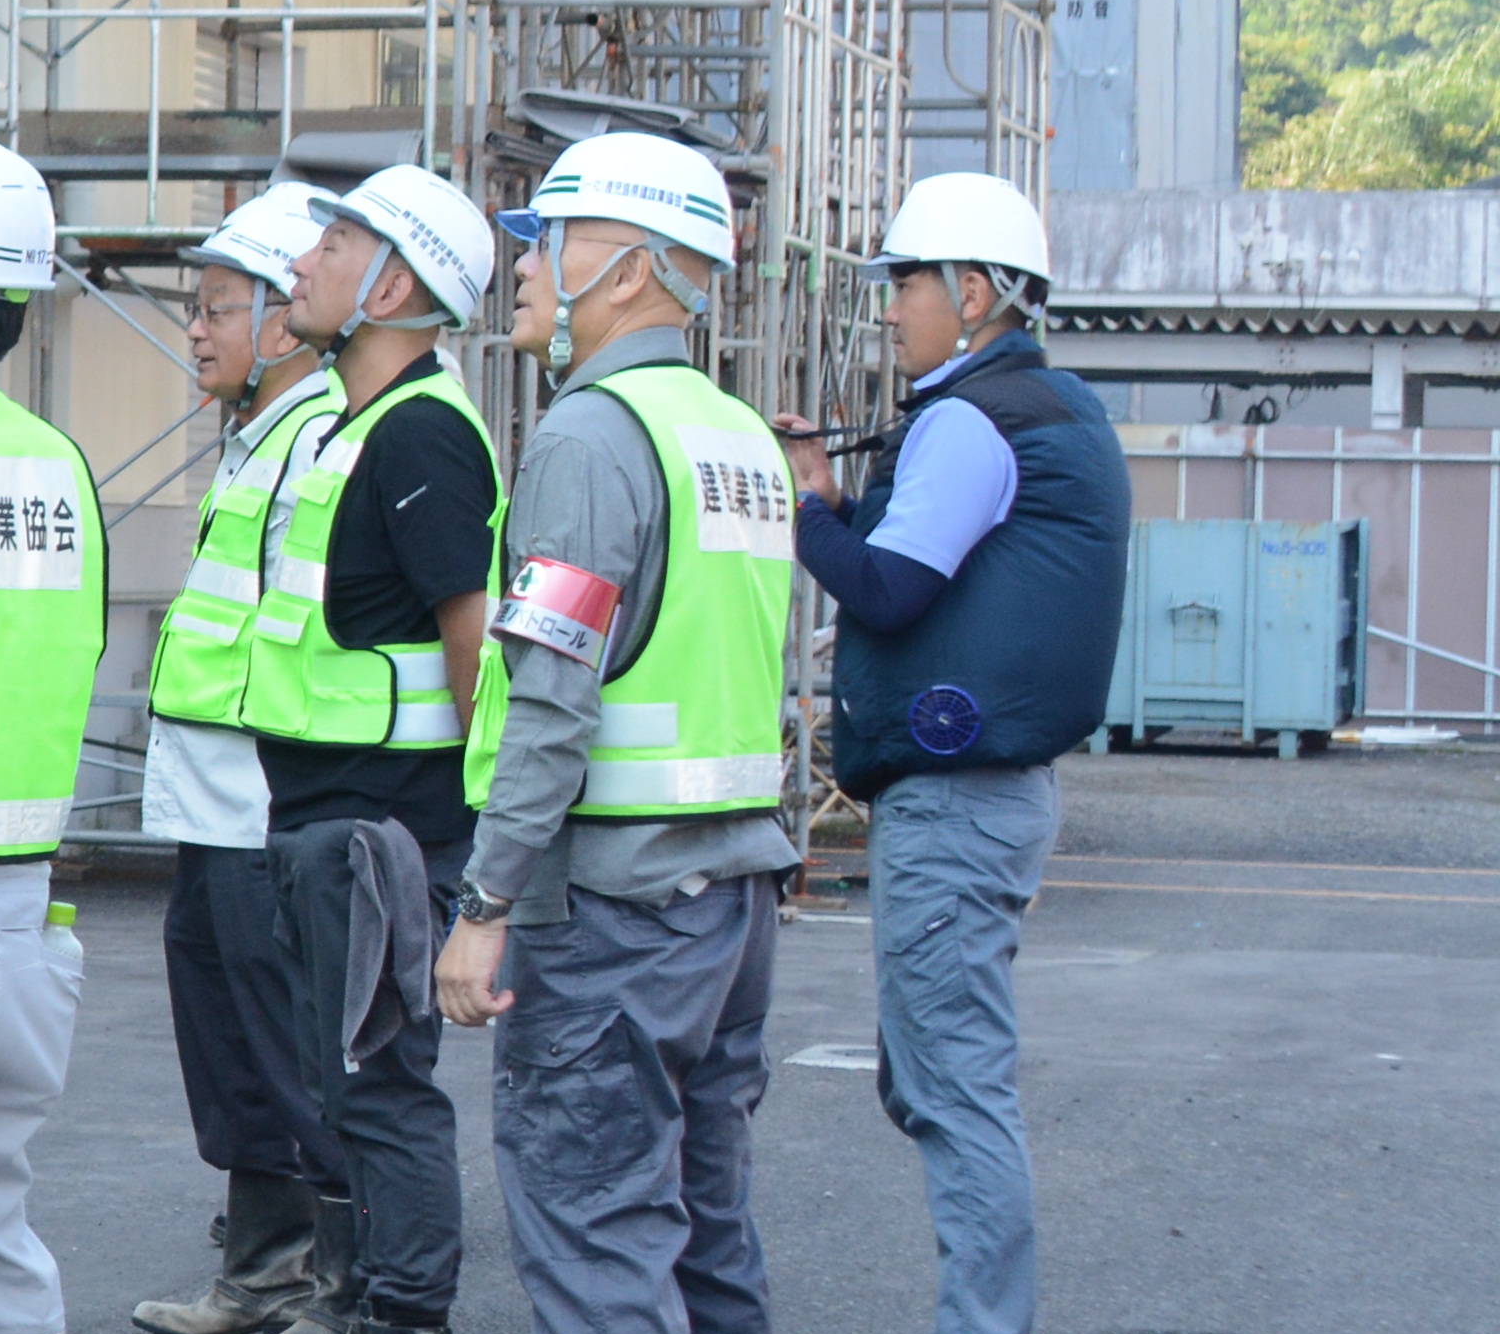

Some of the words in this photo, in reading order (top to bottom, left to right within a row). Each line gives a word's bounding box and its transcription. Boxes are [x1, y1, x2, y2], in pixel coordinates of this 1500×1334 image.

[696, 460, 788, 523] 建設業協会
